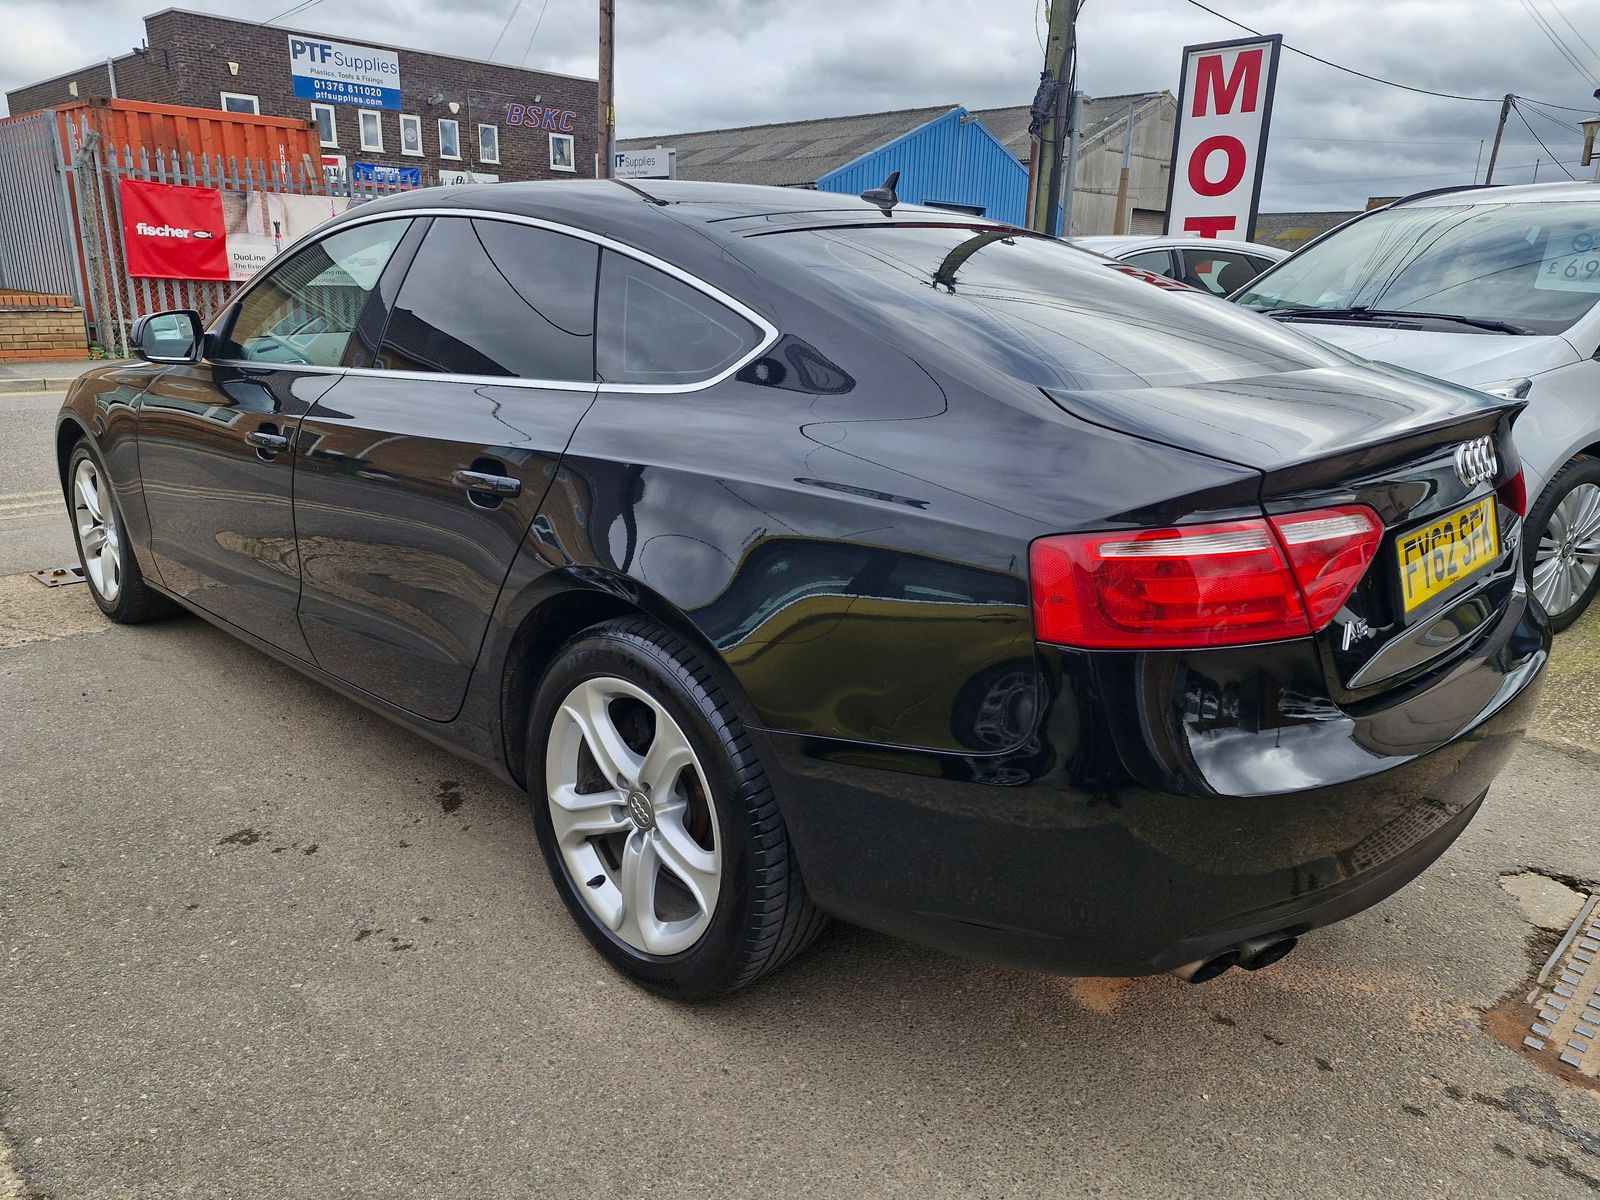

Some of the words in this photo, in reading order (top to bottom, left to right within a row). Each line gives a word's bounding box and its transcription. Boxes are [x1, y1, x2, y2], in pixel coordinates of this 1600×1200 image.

[291, 39, 332, 64] PTF
[334, 51, 398, 75] Supplies
[338, 72, 353, 80] Tools
[362, 75, 384, 85] Fixings
[314, 80, 344, 92] 01376
[347, 84, 382, 97] 811020
[315, 91, 383, 106] ptfsupplies.com
[505, 102, 577, 132] BSKC
[615, 153, 625, 168] TF
[625, 154, 656, 169] Supplies
[136, 222, 190, 239] fischer
[233, 253, 266, 262] DuoLine
[1404, 522, 1458, 599] FY62
